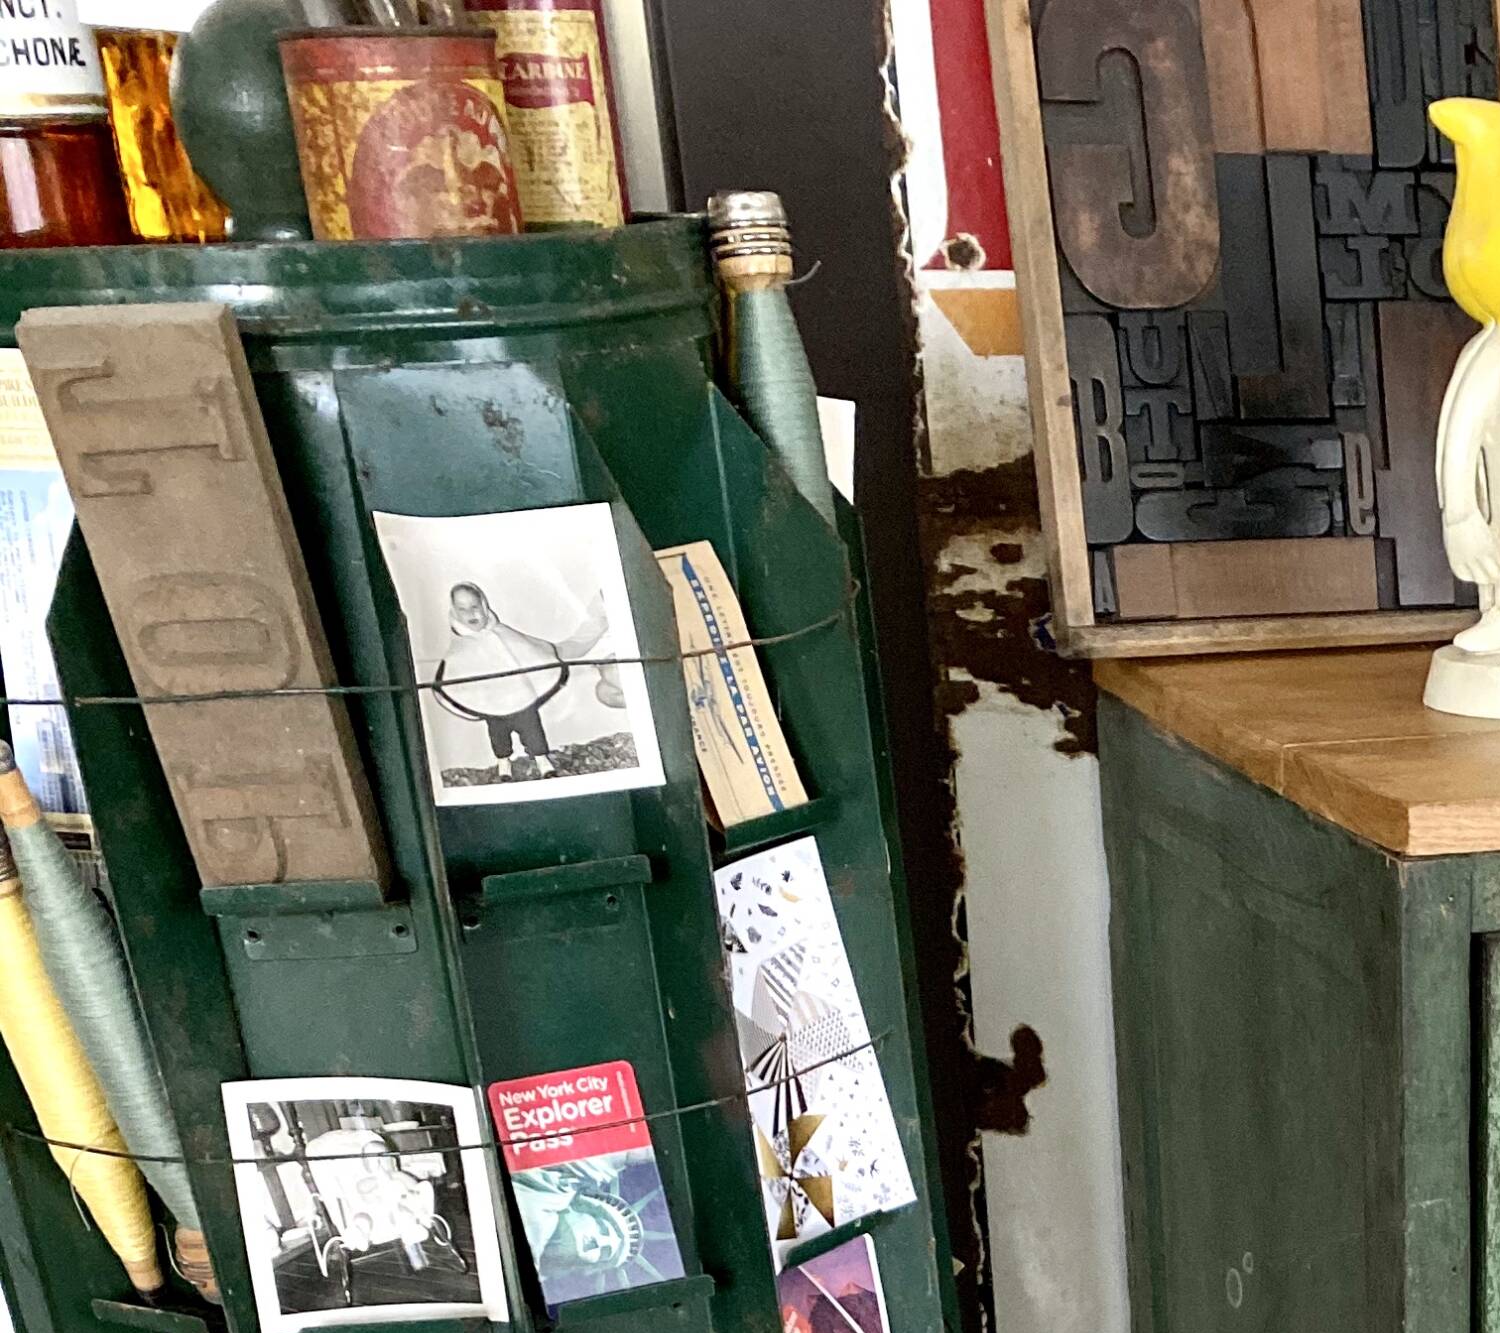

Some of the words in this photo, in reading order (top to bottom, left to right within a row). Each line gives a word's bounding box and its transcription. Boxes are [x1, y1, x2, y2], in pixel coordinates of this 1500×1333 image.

[499, 1088, 536, 1107] New
[537, 1081, 575, 1100] York
[576, 1075, 608, 1092] City
[503, 1094, 613, 1131] Explorer
